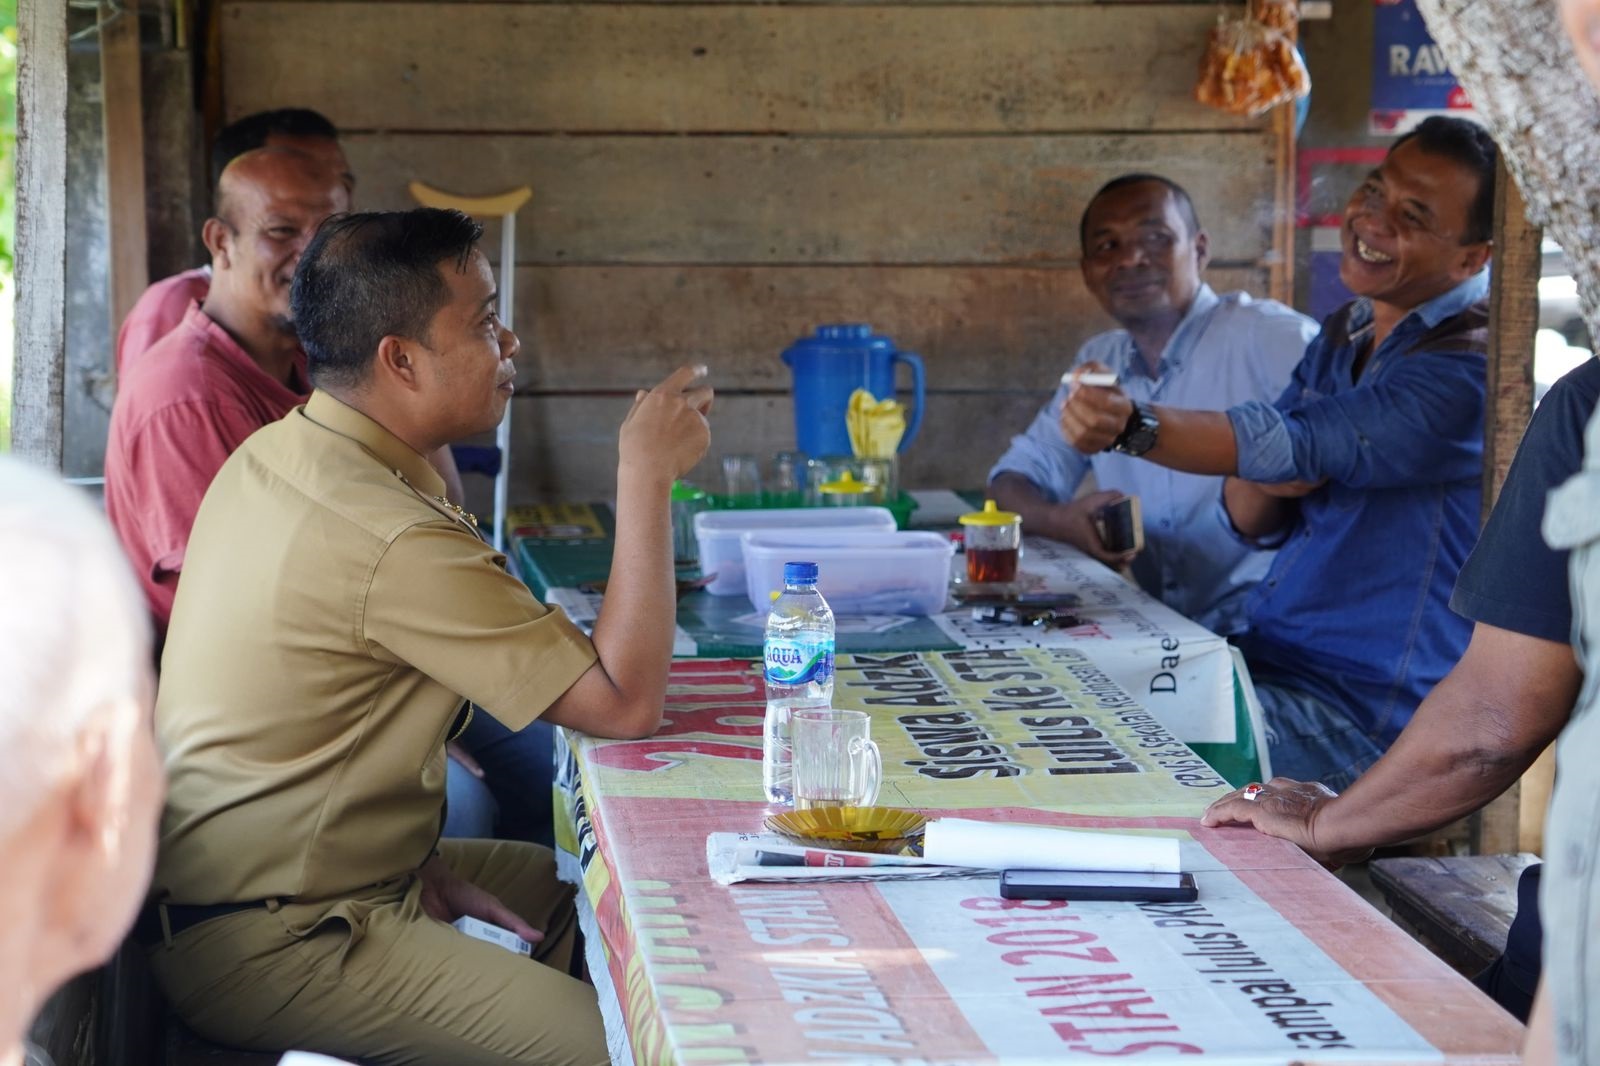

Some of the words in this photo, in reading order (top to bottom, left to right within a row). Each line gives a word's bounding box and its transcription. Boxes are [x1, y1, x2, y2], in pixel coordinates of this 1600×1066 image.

[767, 646, 803, 667] AQUA
[982, 686, 1074, 711] Ke
[898, 711, 1021, 779] Siswa
[1014, 716, 1141, 776] Lulus
[729, 889, 850, 947] STAN
[959, 896, 1120, 966] 2018
[1183, 931, 1274, 974] lulus
[762, 951, 915, 1048] ADZKIA
[1014, 972, 1204, 1057] STAN
